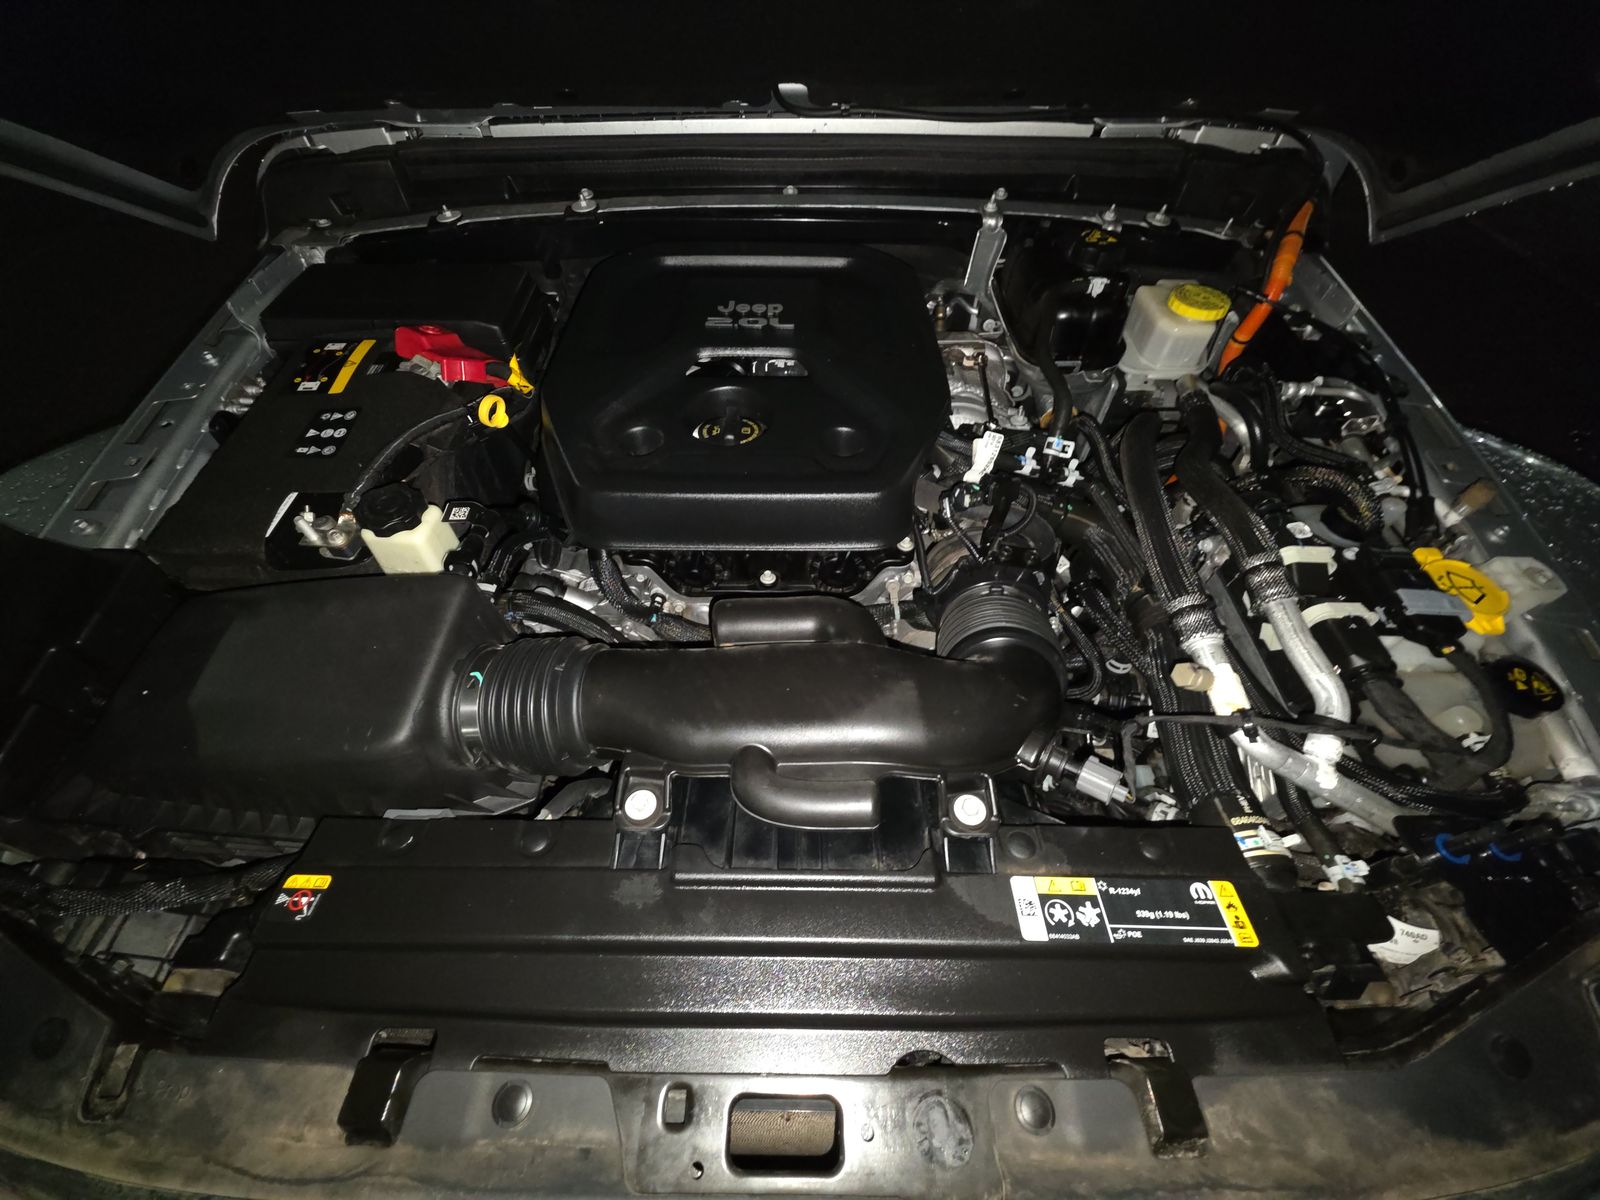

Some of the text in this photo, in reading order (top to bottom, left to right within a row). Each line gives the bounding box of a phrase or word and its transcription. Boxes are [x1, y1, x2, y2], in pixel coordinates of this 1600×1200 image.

[717, 300, 784, 317] Jeep
[705, 317, 795, 330] 2.0L
[1126, 930, 1143, 939] POE
